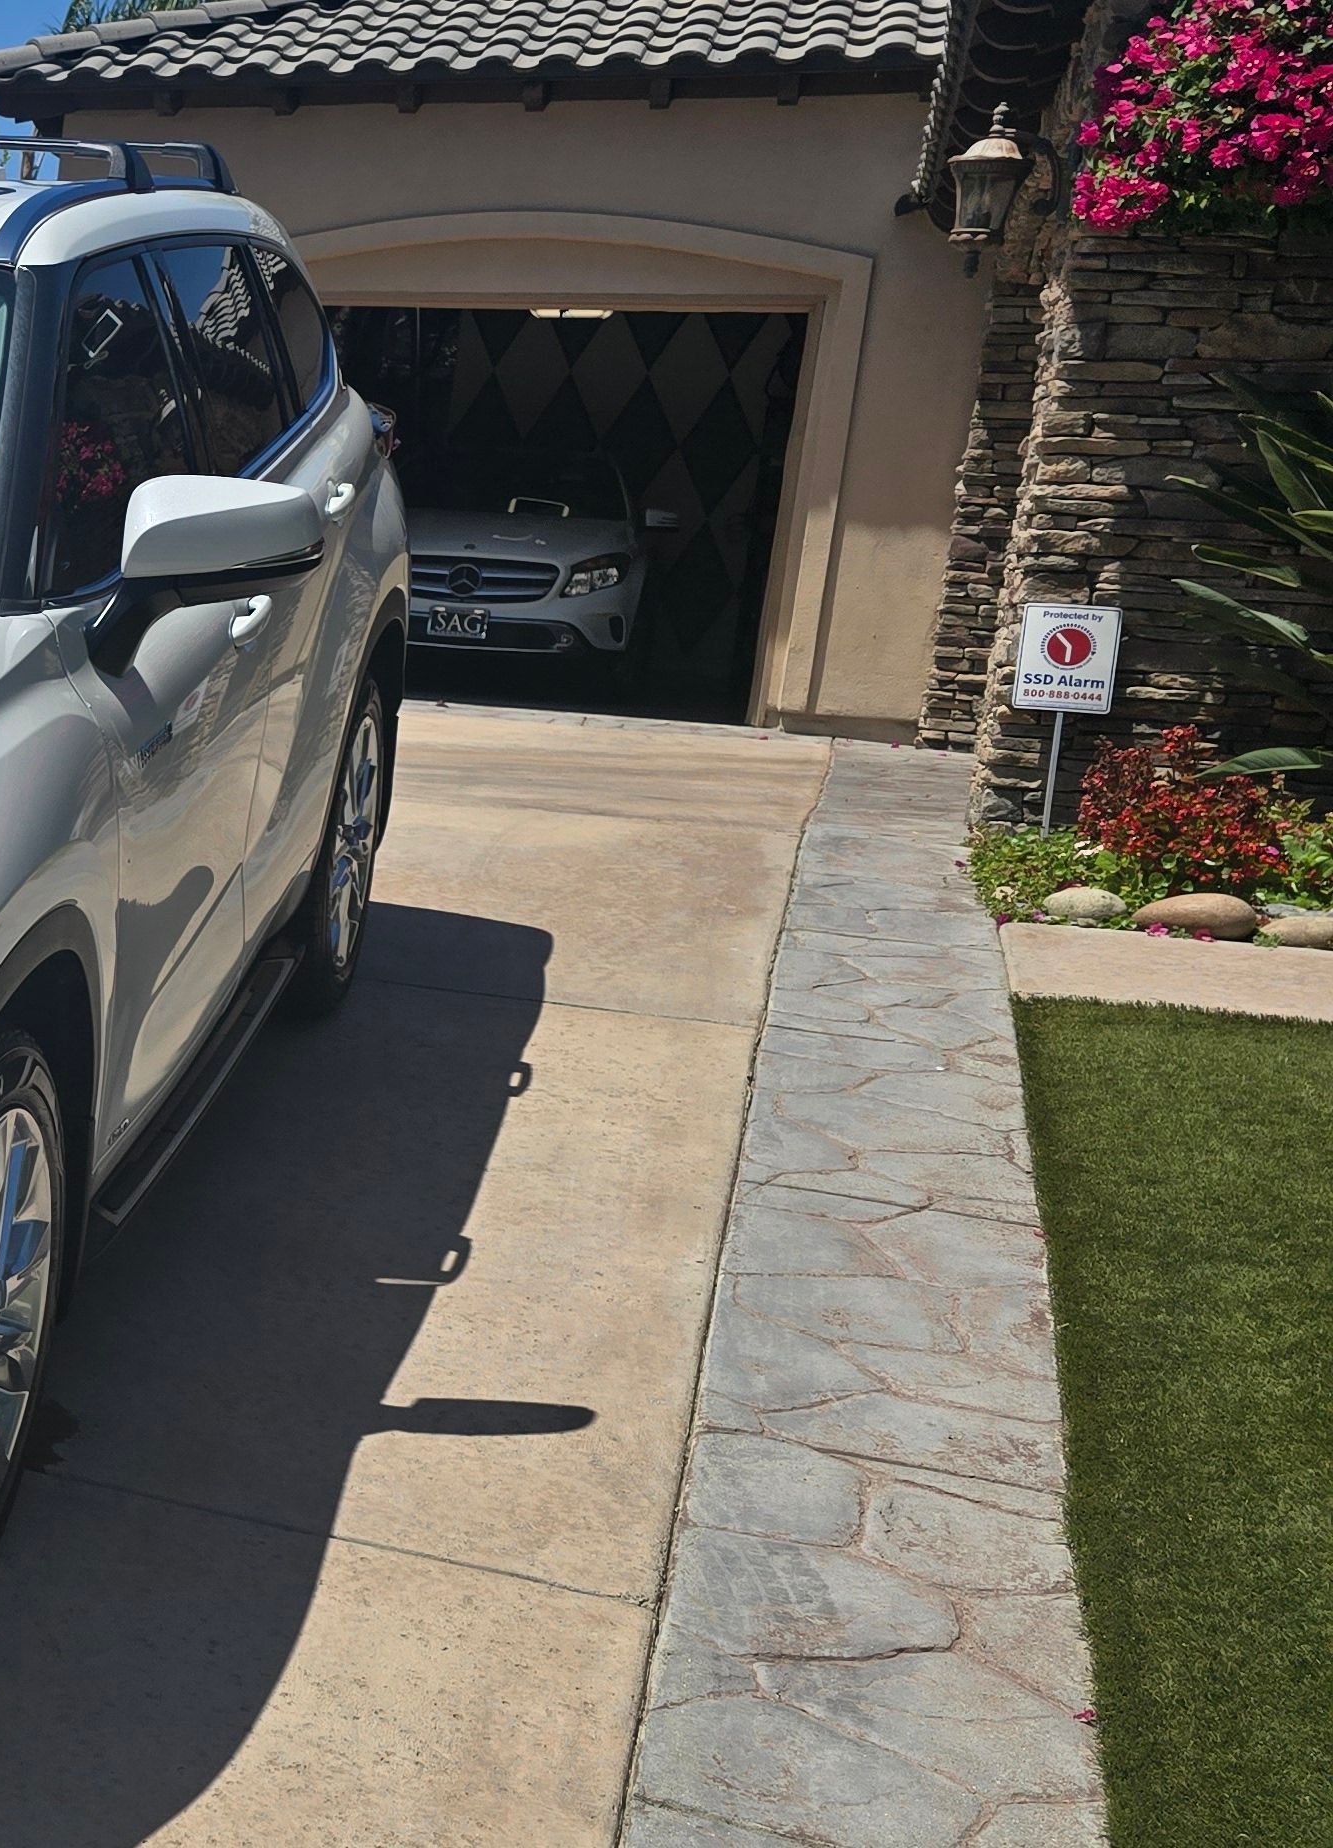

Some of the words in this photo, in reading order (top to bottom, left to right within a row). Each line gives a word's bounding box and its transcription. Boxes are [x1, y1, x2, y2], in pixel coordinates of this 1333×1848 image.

[435, 612, 481, 633] SAG
[1043, 611, 1089, 620] Protected
[1091, 614, 1103, 622] by
[1023, 673, 1053, 685] SSD
[1057, 675, 1105, 689] Alarm
